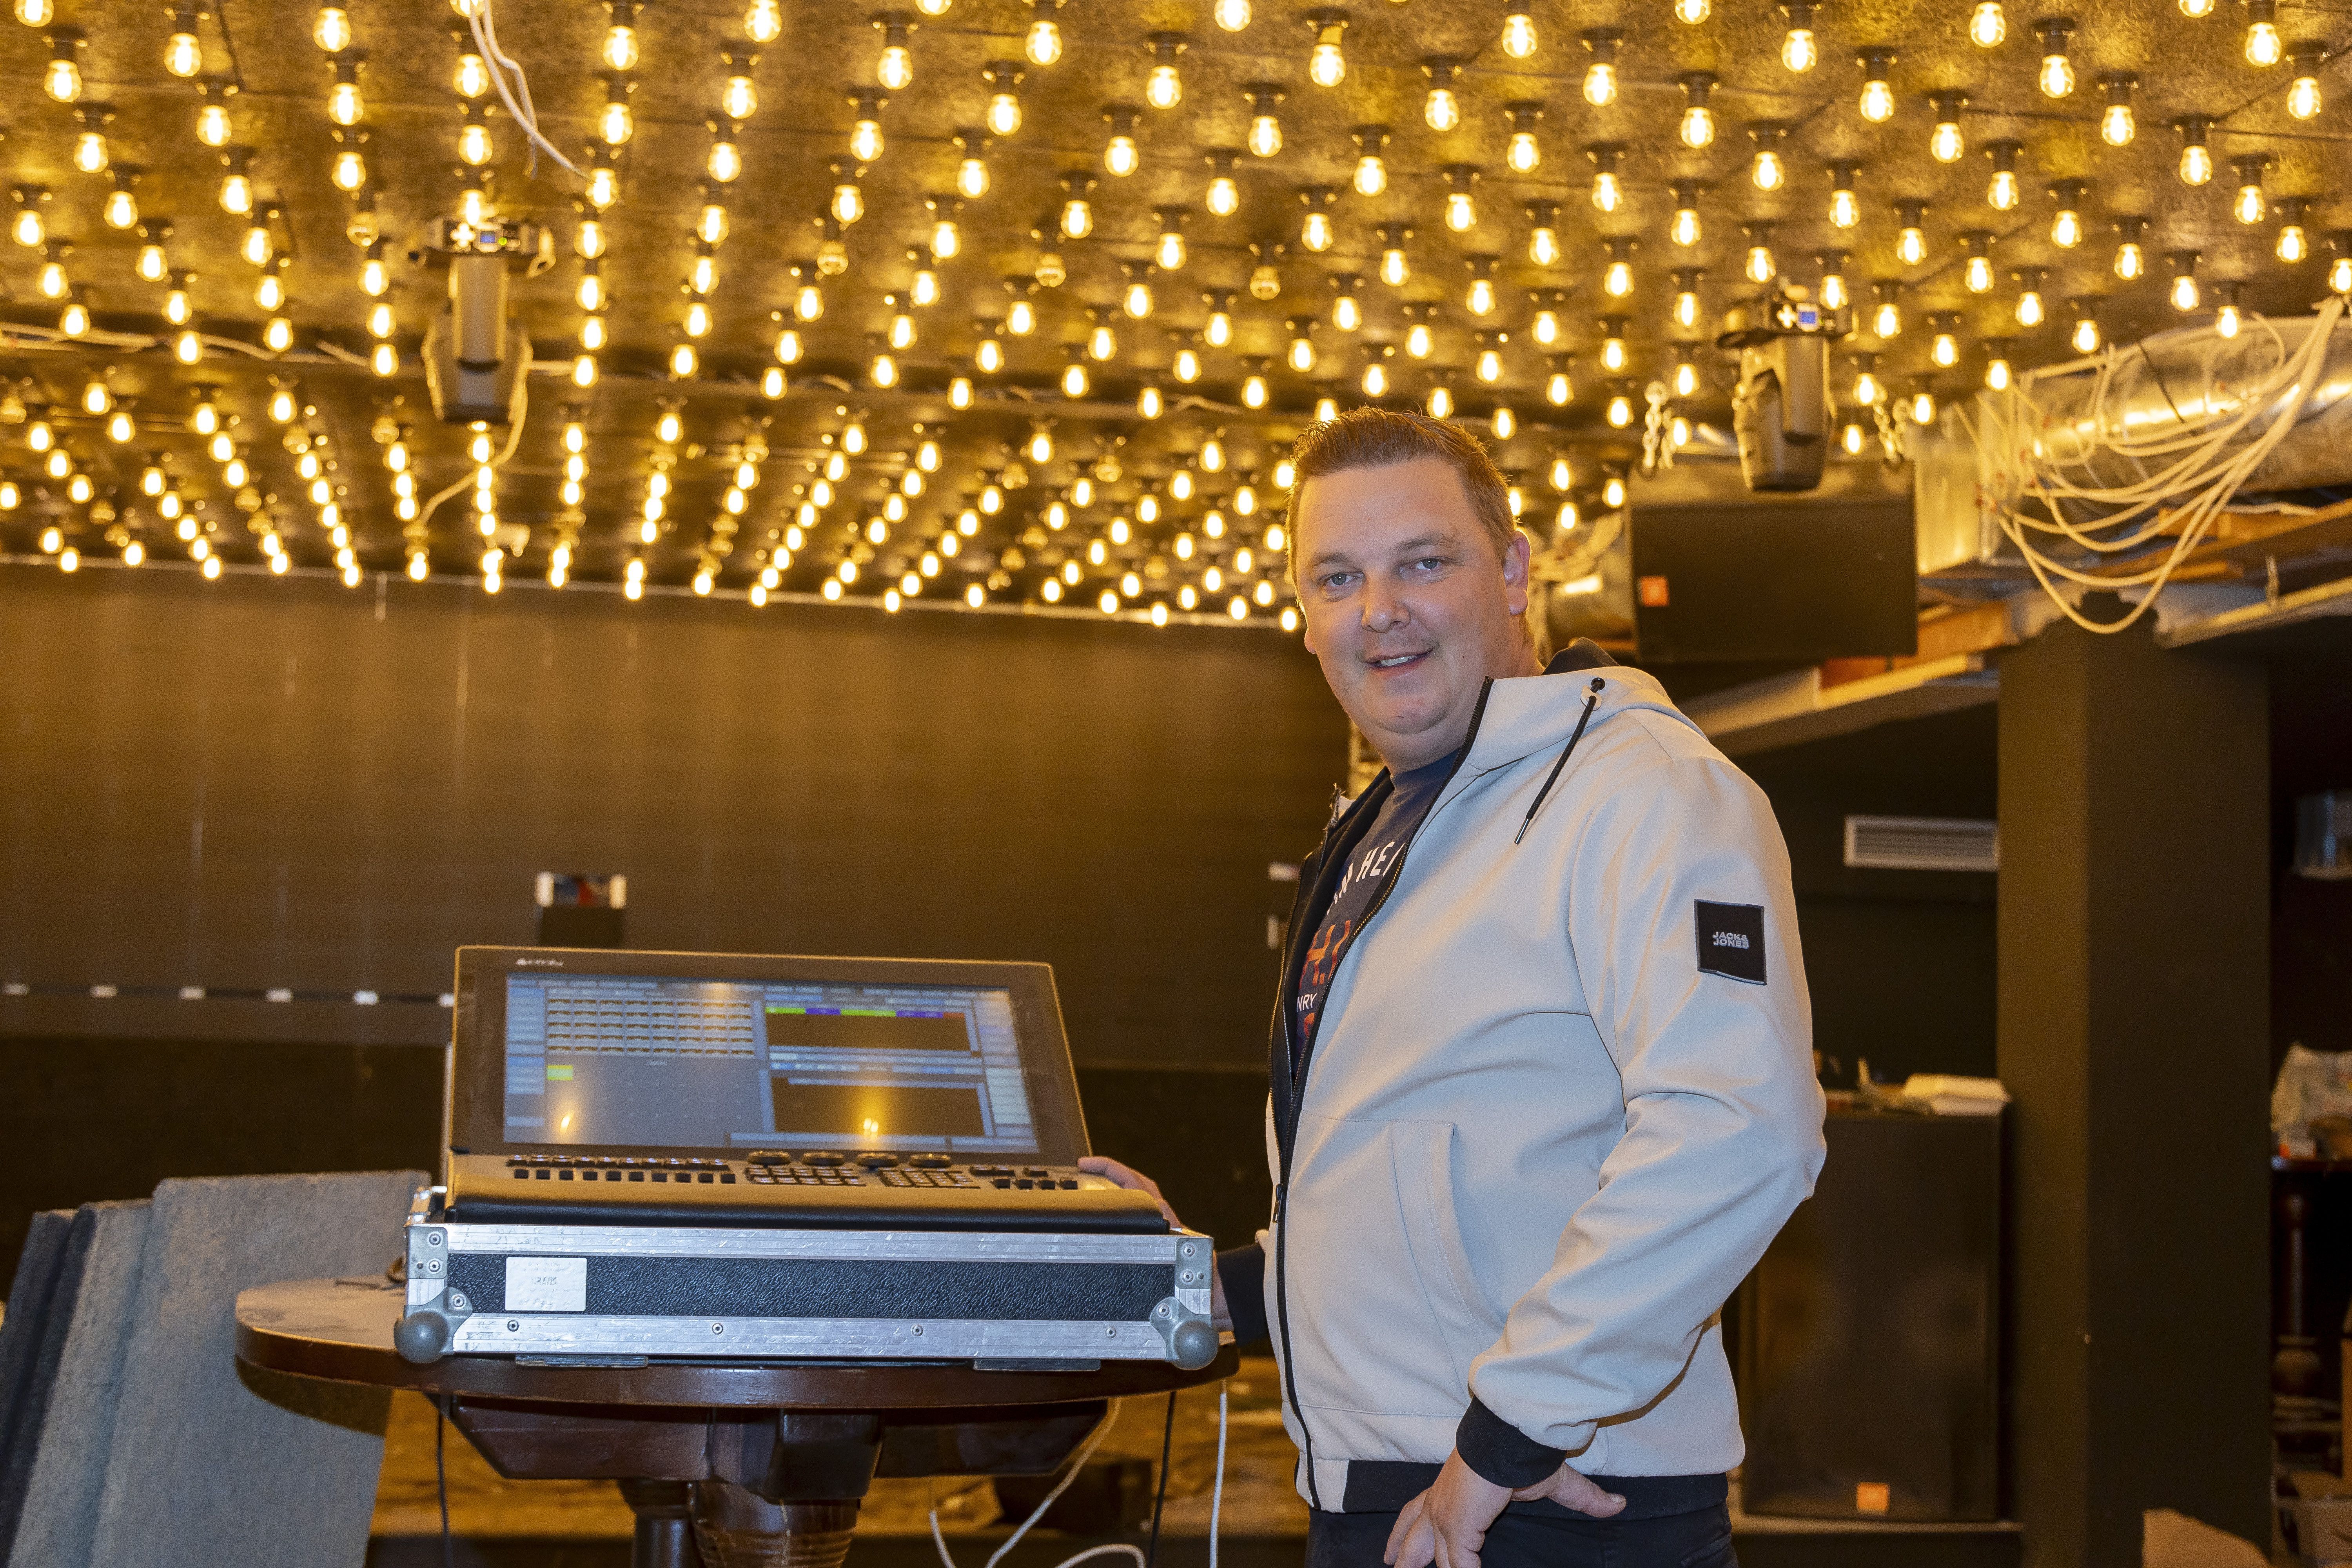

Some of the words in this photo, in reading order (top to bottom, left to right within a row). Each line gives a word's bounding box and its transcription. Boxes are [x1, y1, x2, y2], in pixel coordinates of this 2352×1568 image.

[1355, 841, 1406, 883] HE
[1713, 931, 1748, 941] JACK&
[1713, 938, 1749, 949] JONES
